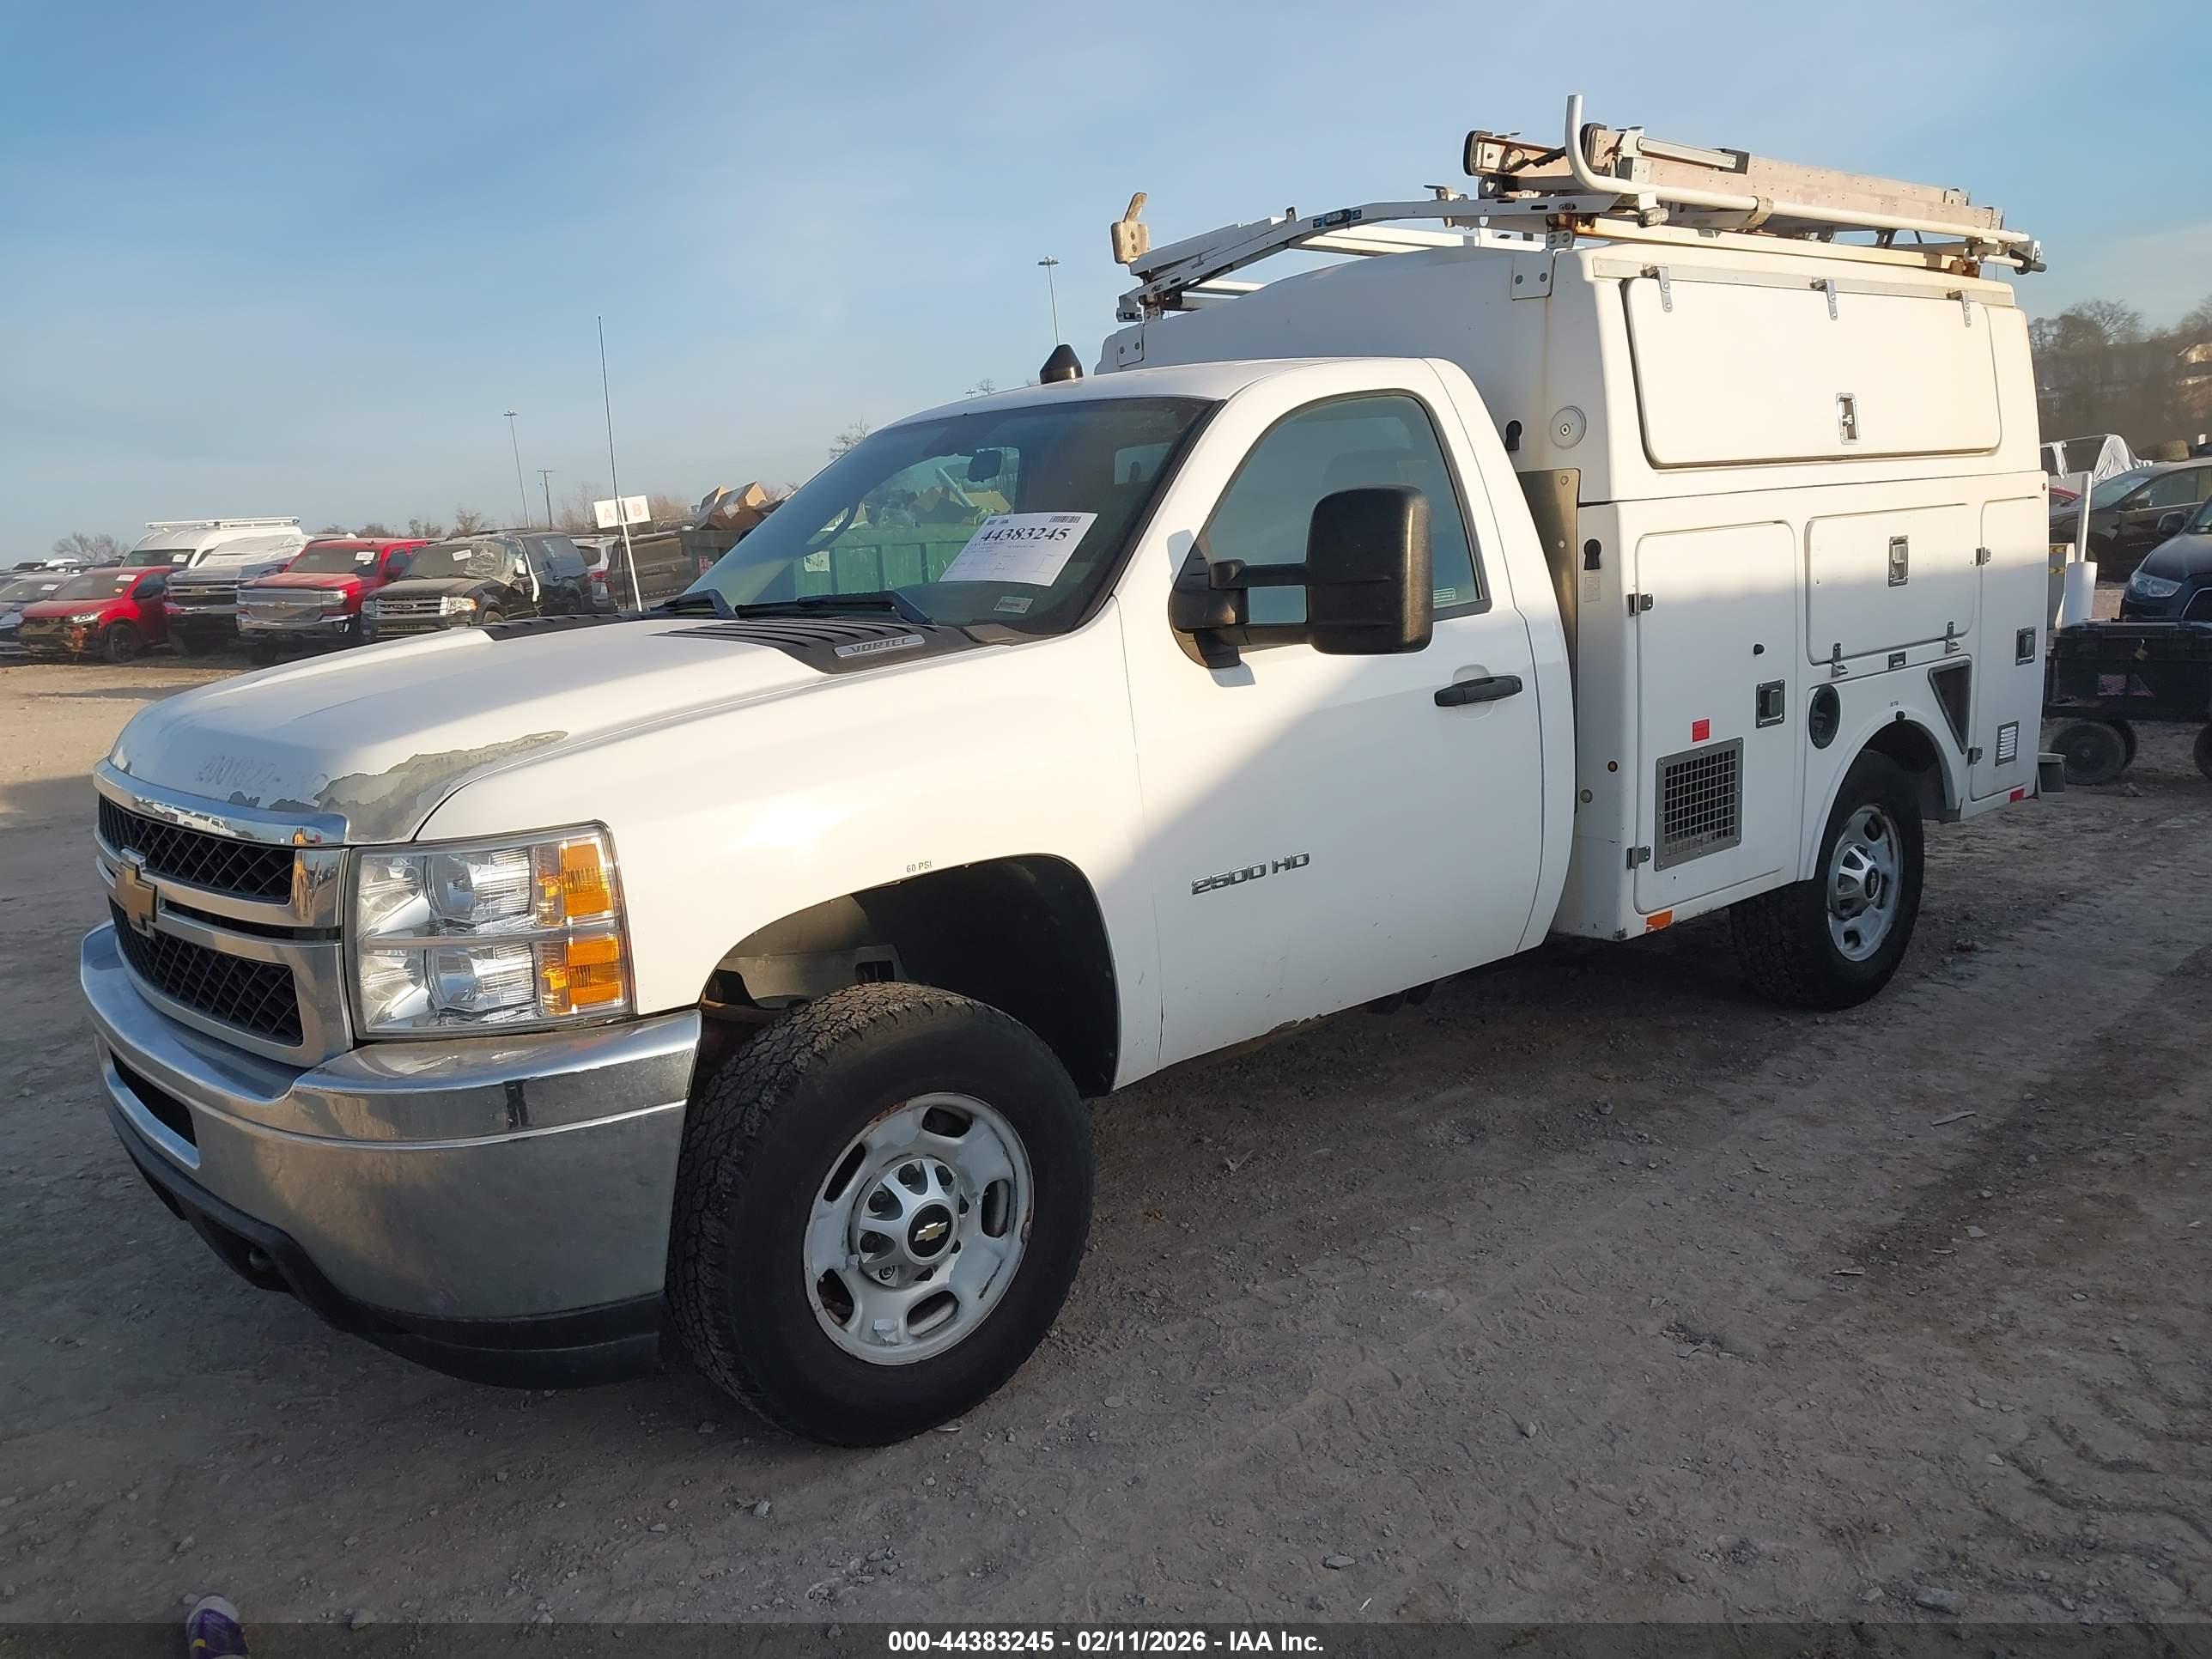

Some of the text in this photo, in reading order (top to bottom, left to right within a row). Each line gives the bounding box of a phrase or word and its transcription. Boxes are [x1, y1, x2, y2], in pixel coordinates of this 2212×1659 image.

[632, 503, 642, 517] B
[981, 527, 1072, 541] 44383245
[849, 637, 912, 653] VORTEC
[918, 860, 933, 871] PSI
[1191, 851, 1310, 896] 2500 HD
